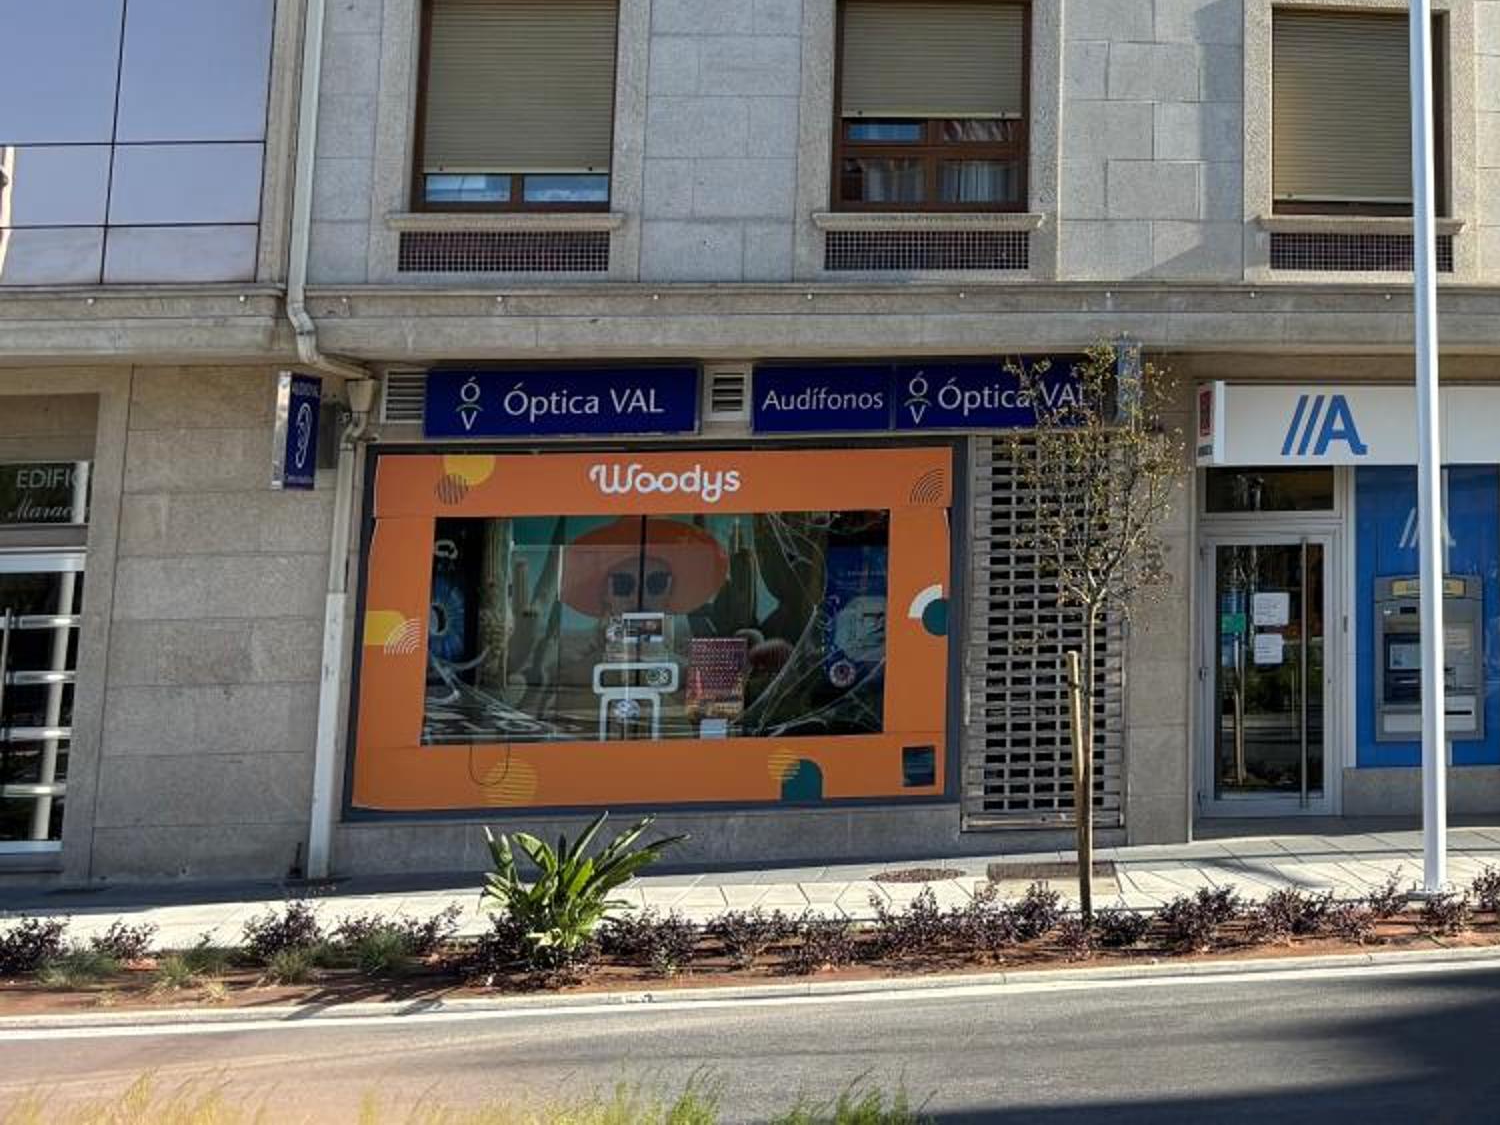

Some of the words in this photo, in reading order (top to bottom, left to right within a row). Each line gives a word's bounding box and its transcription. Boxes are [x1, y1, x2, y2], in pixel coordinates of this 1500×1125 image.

[504, 382, 599, 423] Óptica
[610, 388, 665, 413] VAL
[762, 386, 884, 411] Audífonos
[938, 377, 1032, 416] Óptica
[589, 464, 741, 503] Woodys
